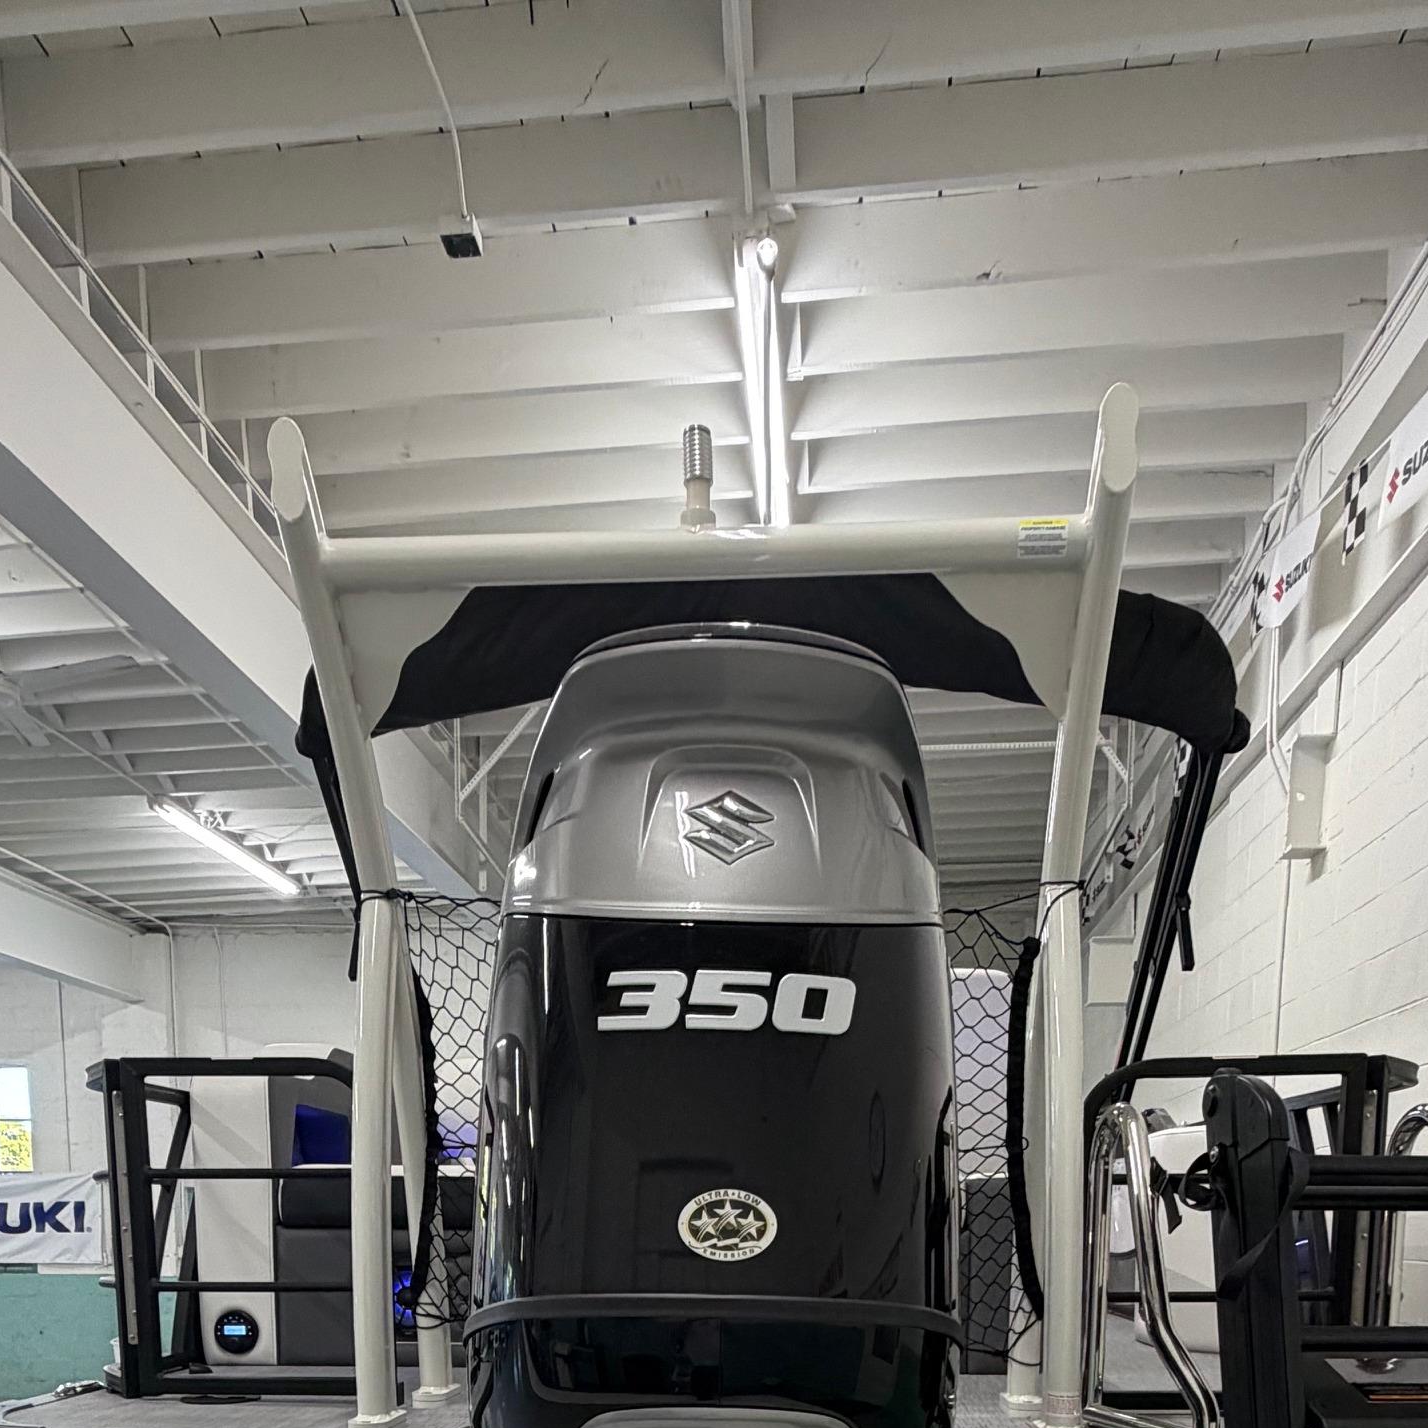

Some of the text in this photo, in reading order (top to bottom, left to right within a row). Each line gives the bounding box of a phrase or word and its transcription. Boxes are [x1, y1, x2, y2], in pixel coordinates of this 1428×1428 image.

[597, 969, 857, 1036] 350
[694, 1189, 761, 1207] ULTRA LOW
[702, 1248, 755, 1259] EMISSION
